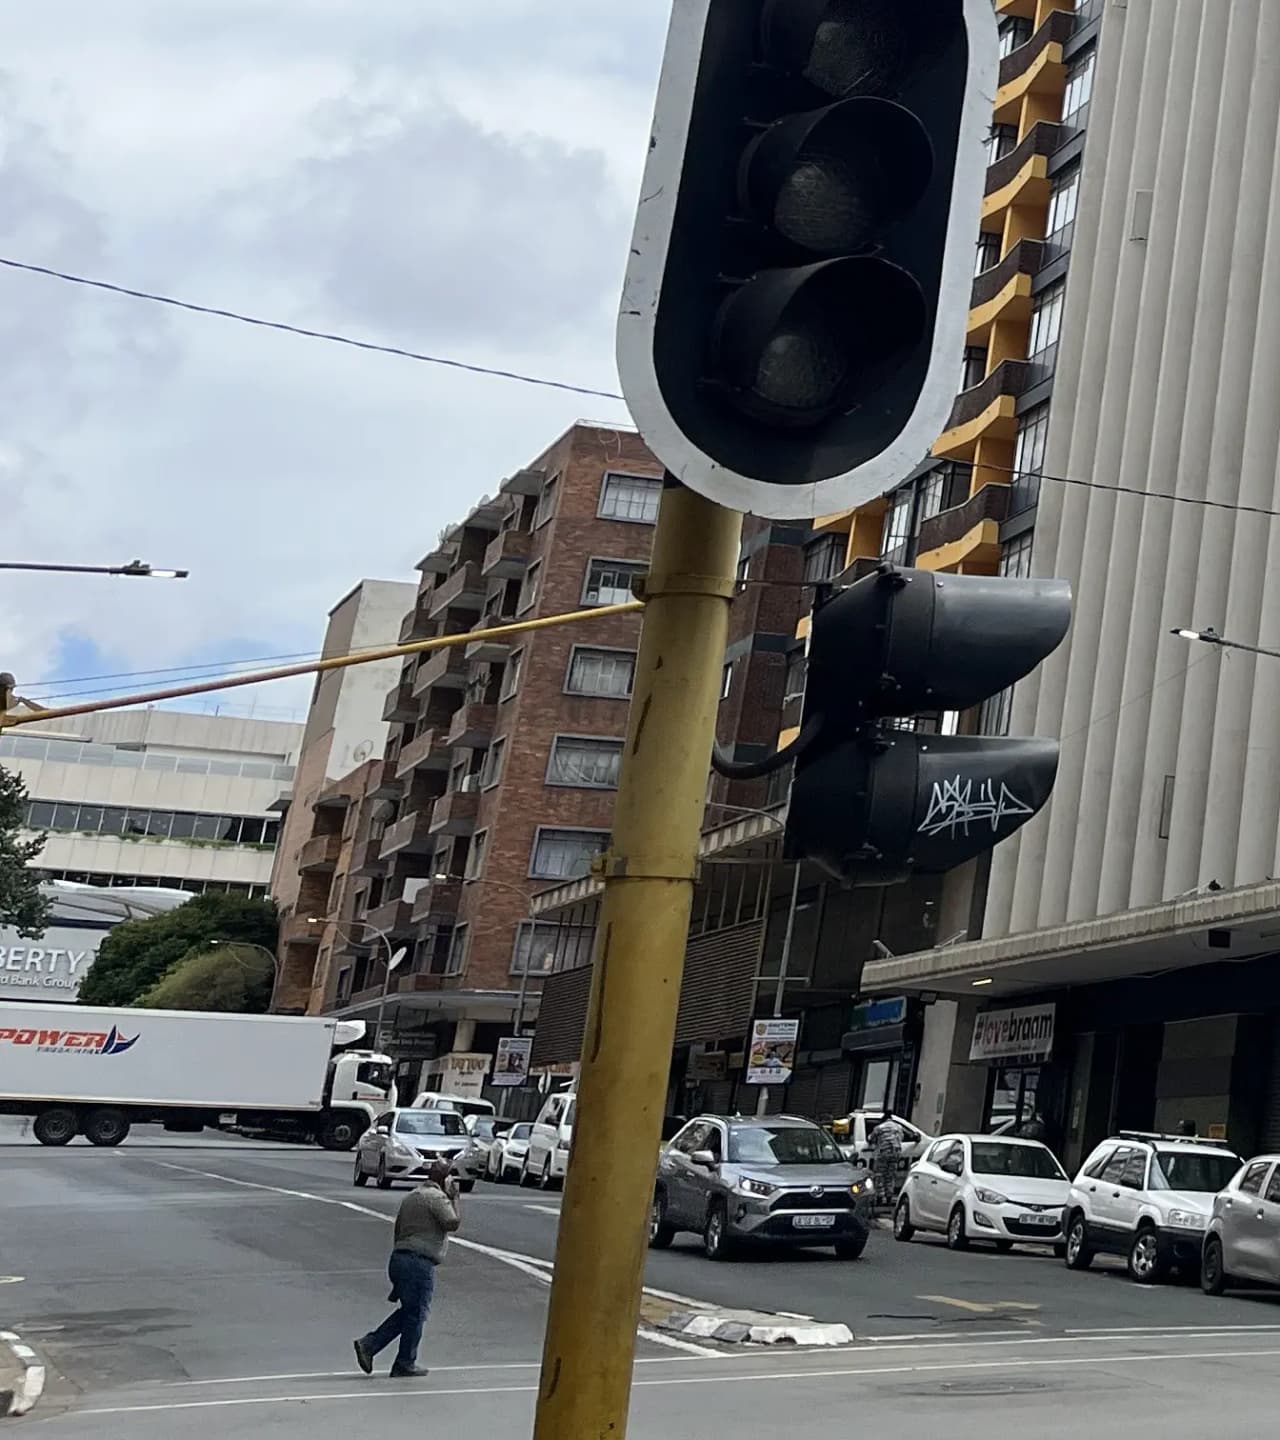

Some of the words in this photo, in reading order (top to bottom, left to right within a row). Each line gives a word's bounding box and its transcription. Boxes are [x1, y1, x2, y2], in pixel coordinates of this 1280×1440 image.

[10, 974, 40, 986] Bank
[0, 1028, 108, 1049] POWER
[974, 1011, 1053, 1046] #lovebraam
